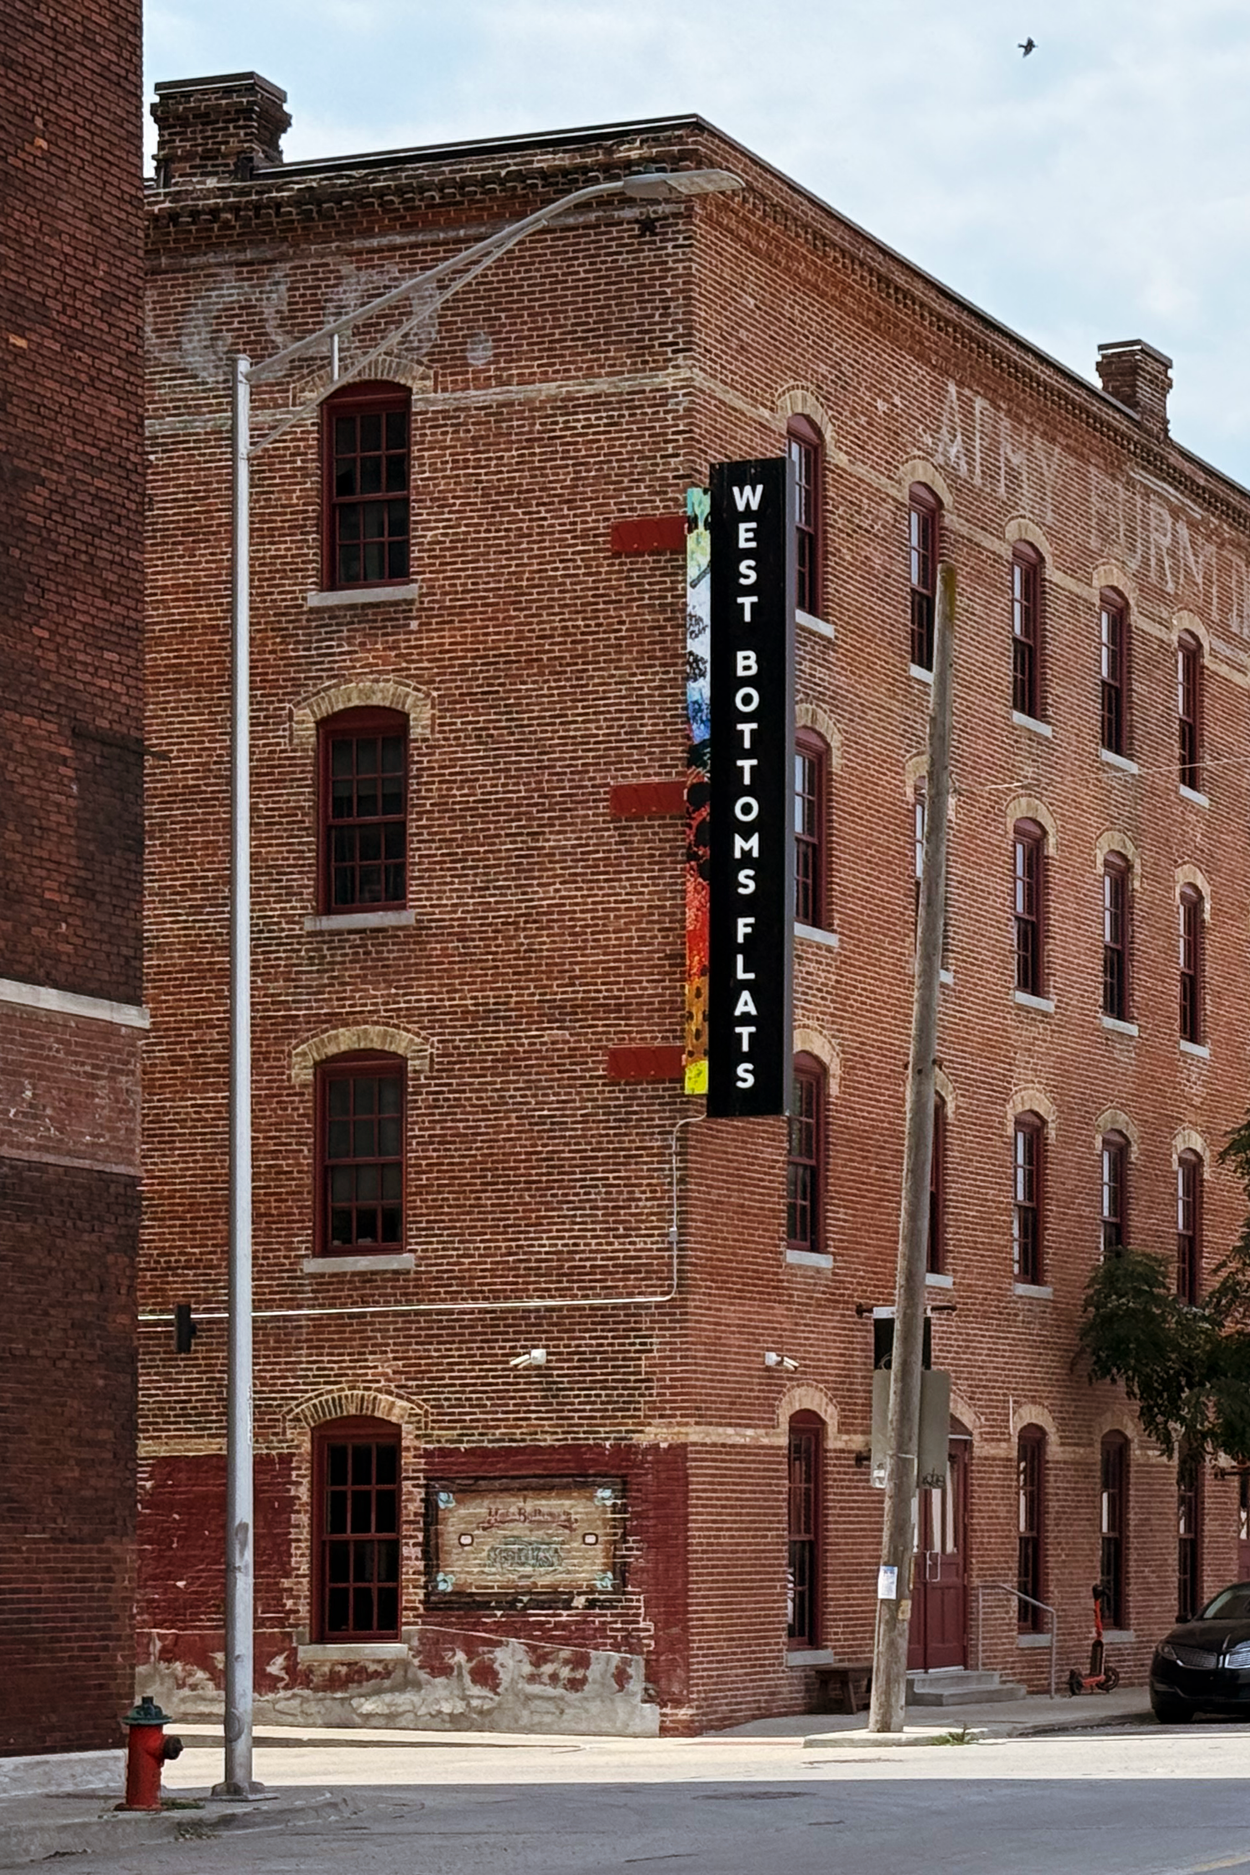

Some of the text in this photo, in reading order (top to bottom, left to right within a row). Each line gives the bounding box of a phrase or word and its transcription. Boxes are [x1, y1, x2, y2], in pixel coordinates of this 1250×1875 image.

[731, 483, 764, 1089] WEST BOTTOMS FLATS
